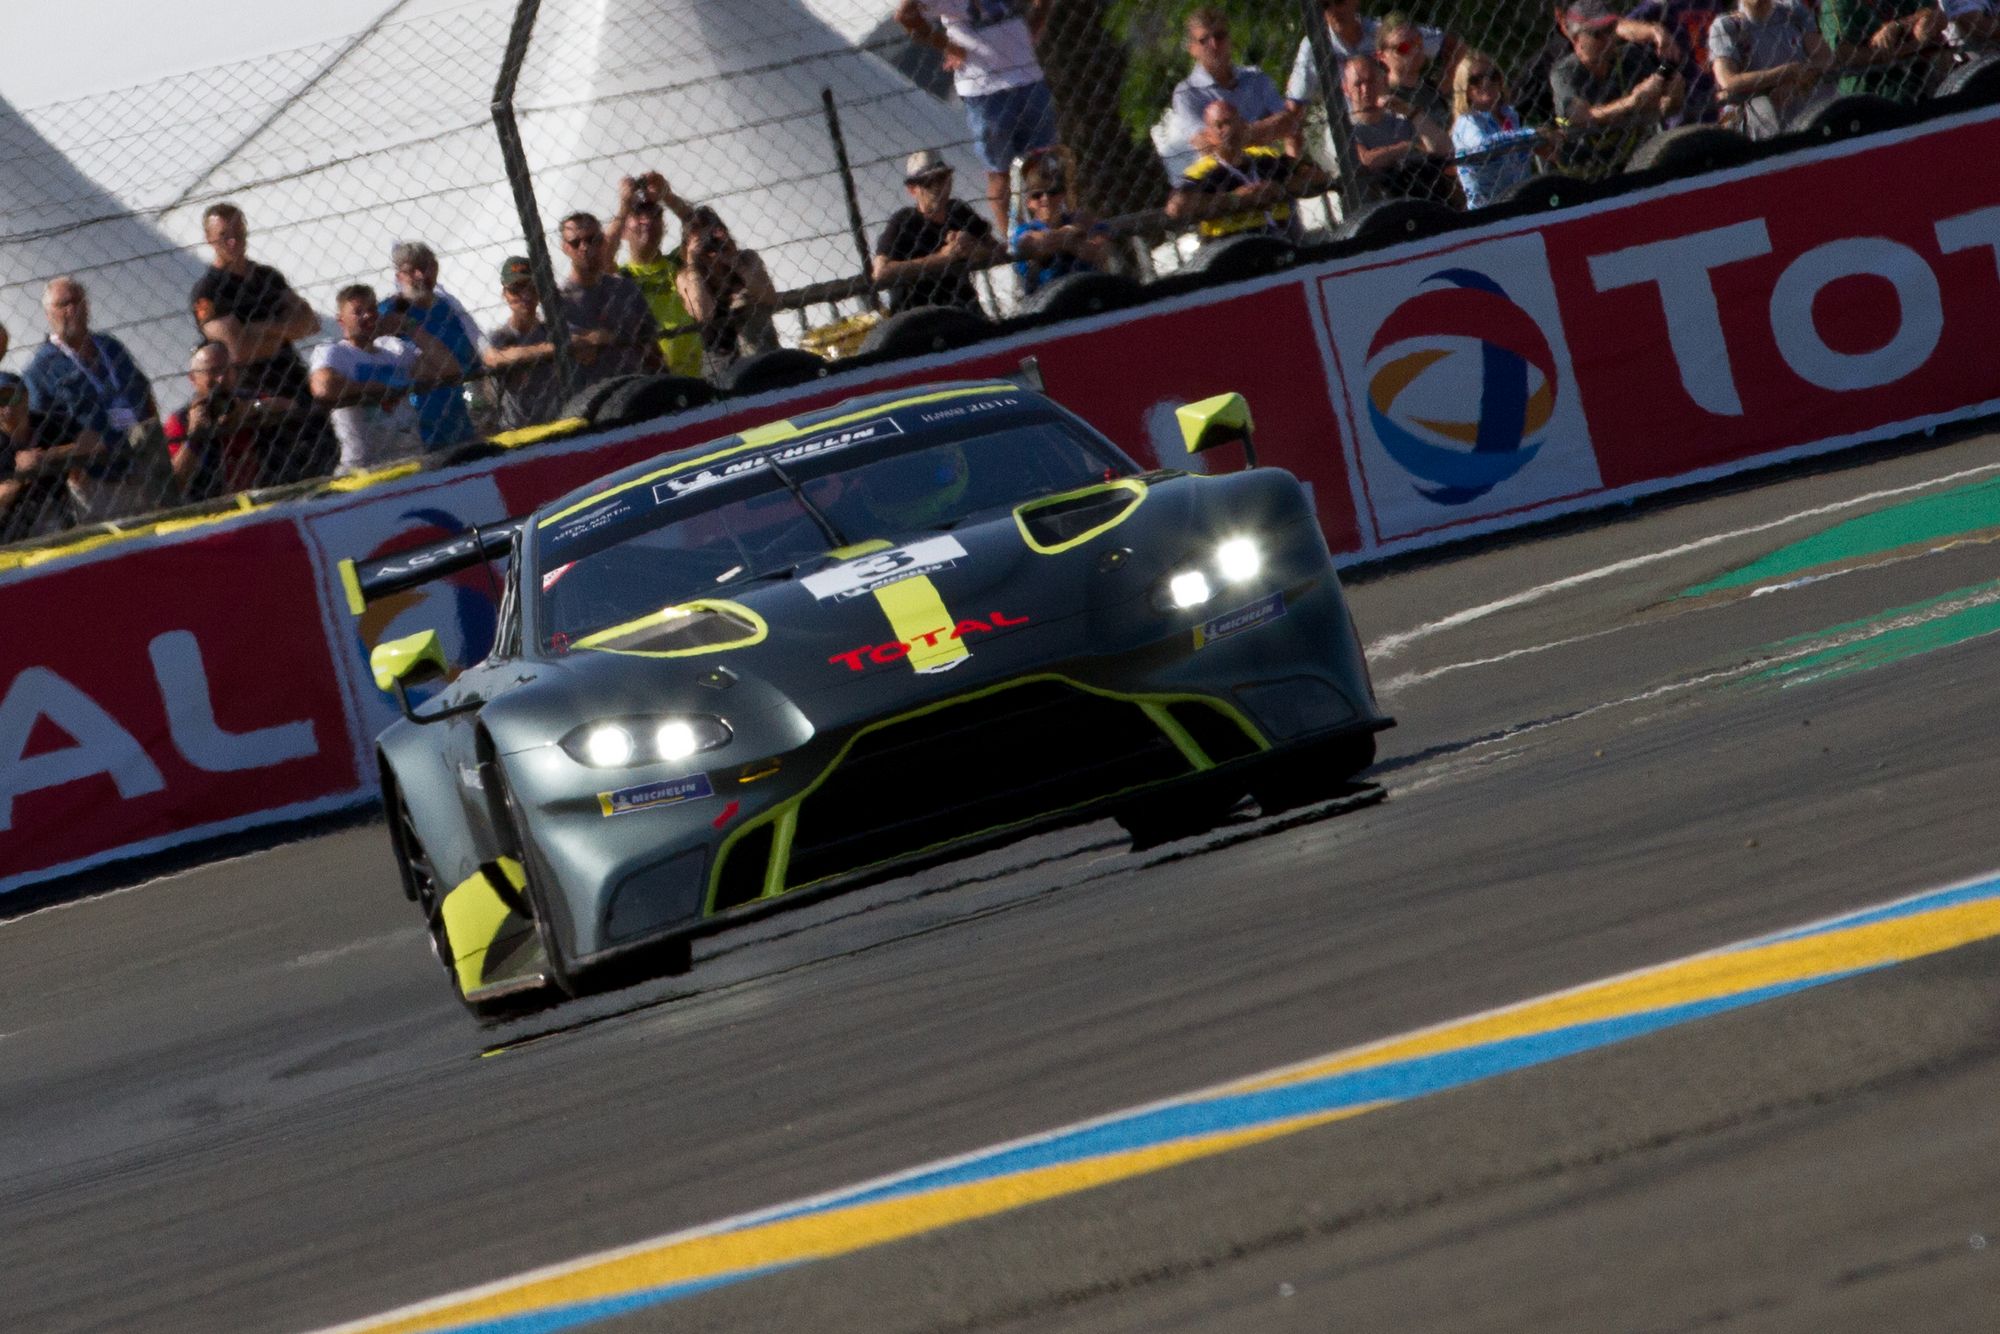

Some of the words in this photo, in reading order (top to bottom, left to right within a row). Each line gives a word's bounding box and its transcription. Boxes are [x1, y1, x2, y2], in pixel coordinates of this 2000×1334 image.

[724, 428, 875, 475] MICHELIN
[852, 550, 915, 579] 3
[828, 611, 1030, 672] TOTAL
[631, 782, 697, 805] MICHELIN
